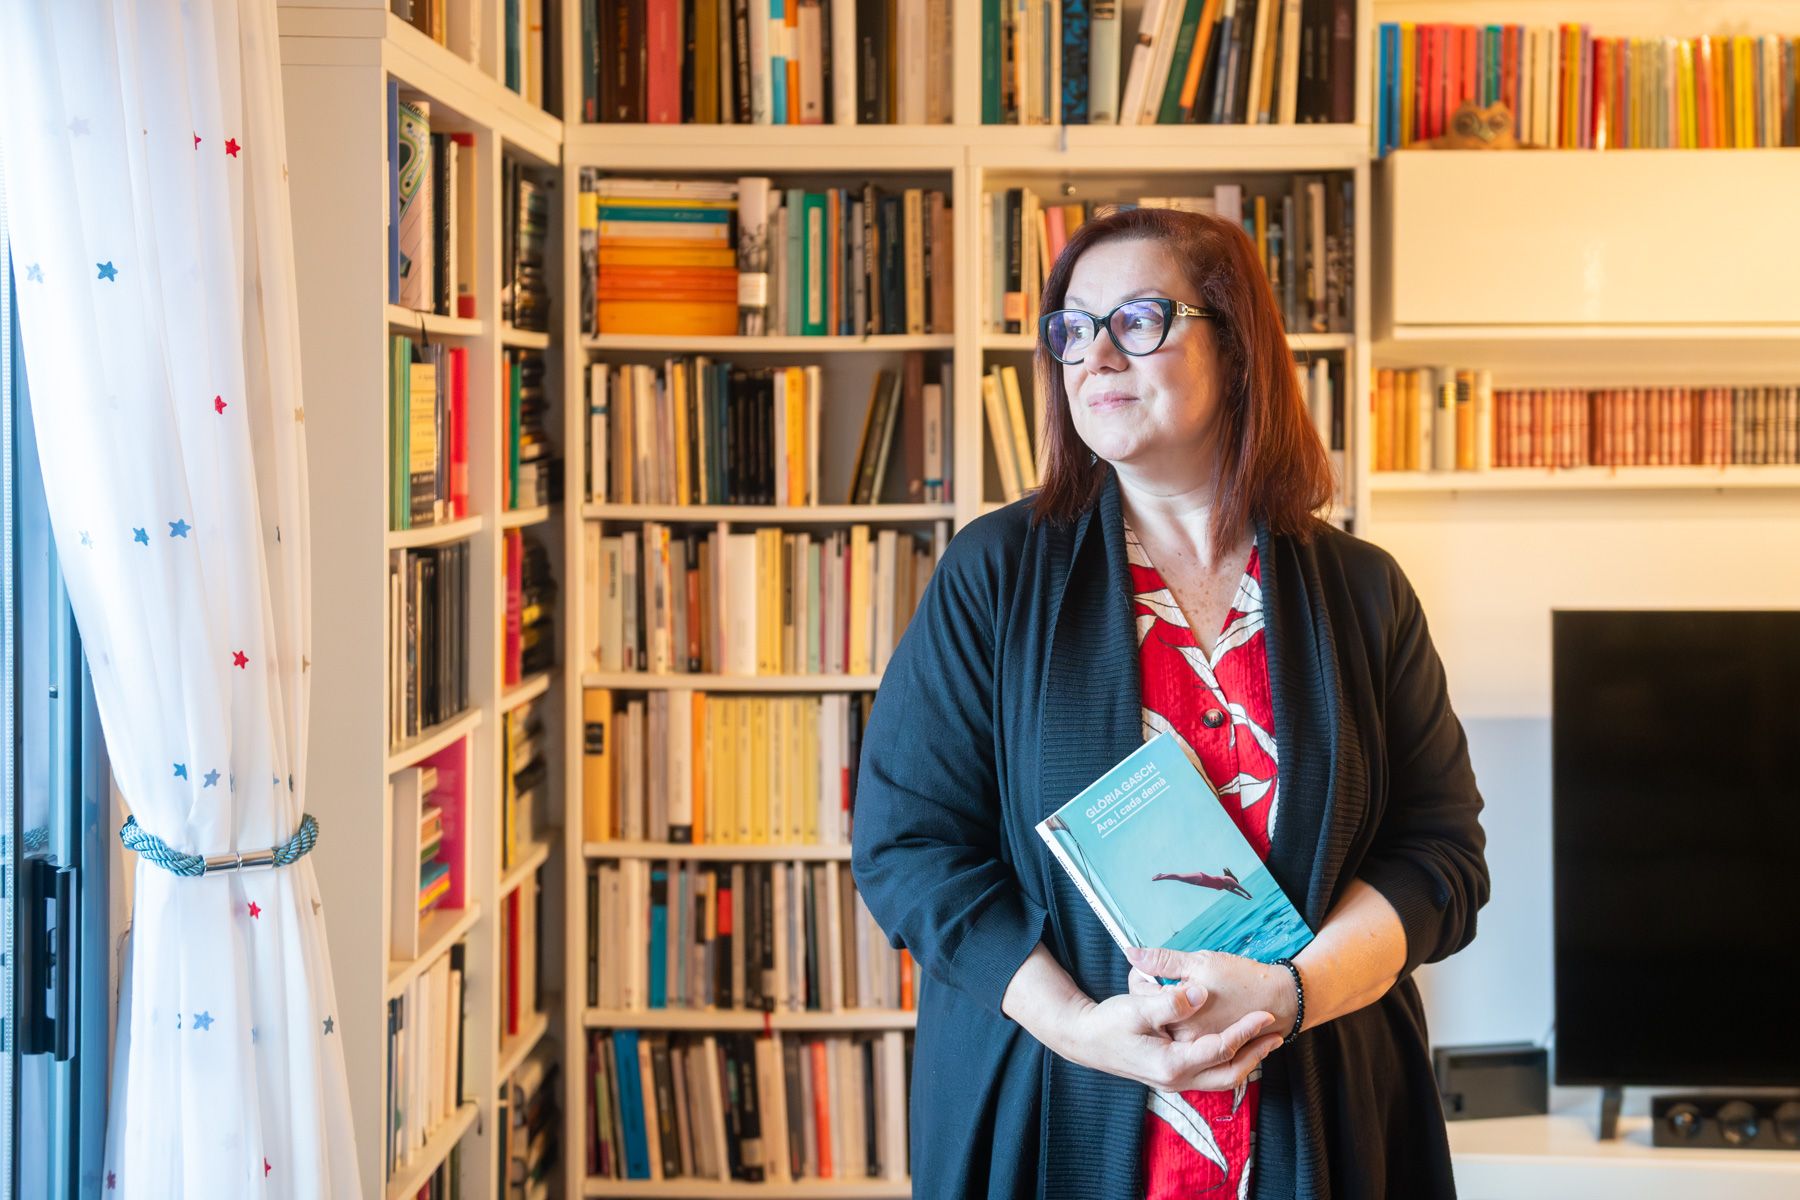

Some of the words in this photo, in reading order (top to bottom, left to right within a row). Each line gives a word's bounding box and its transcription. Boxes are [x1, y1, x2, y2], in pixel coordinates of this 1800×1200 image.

[1086, 788, 1123, 818] GLÒRIA
[1121, 762, 1156, 792] GASCH
[1096, 817, 1117, 834] Ara,
[1119, 798, 1142, 816] cada
[1142, 777, 1167, 799] demà
